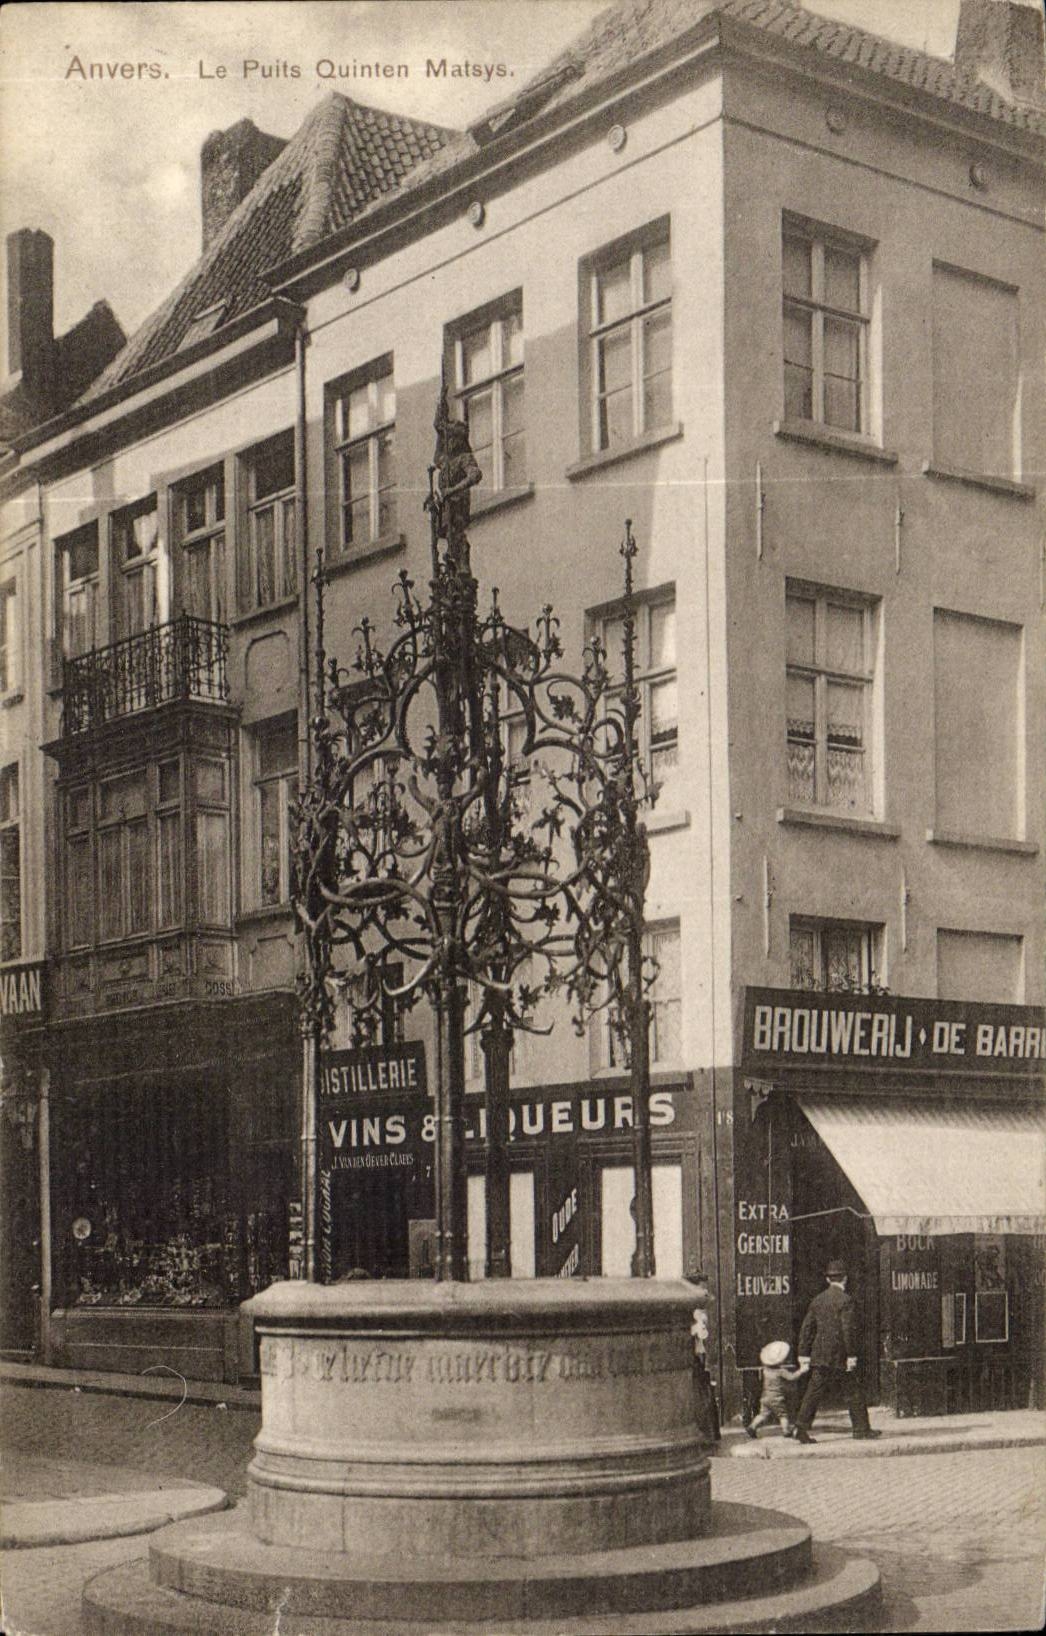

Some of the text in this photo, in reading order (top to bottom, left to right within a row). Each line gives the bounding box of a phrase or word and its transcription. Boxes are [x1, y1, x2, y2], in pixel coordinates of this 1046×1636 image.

[753, 1005, 913, 1058] BROUWERIJ
[932, 1021, 966, 1055] DE
[321, 1057, 418, 1096] ISTILLERIE
[328, 1114, 406, 1149] VINS
[738, 1200, 789, 1221] EXTRA
[737, 1231, 790, 1255] GERSTEN
[737, 1272, 790, 1296] LEUVENS
[891, 1270, 938, 1291] LIMONADE
